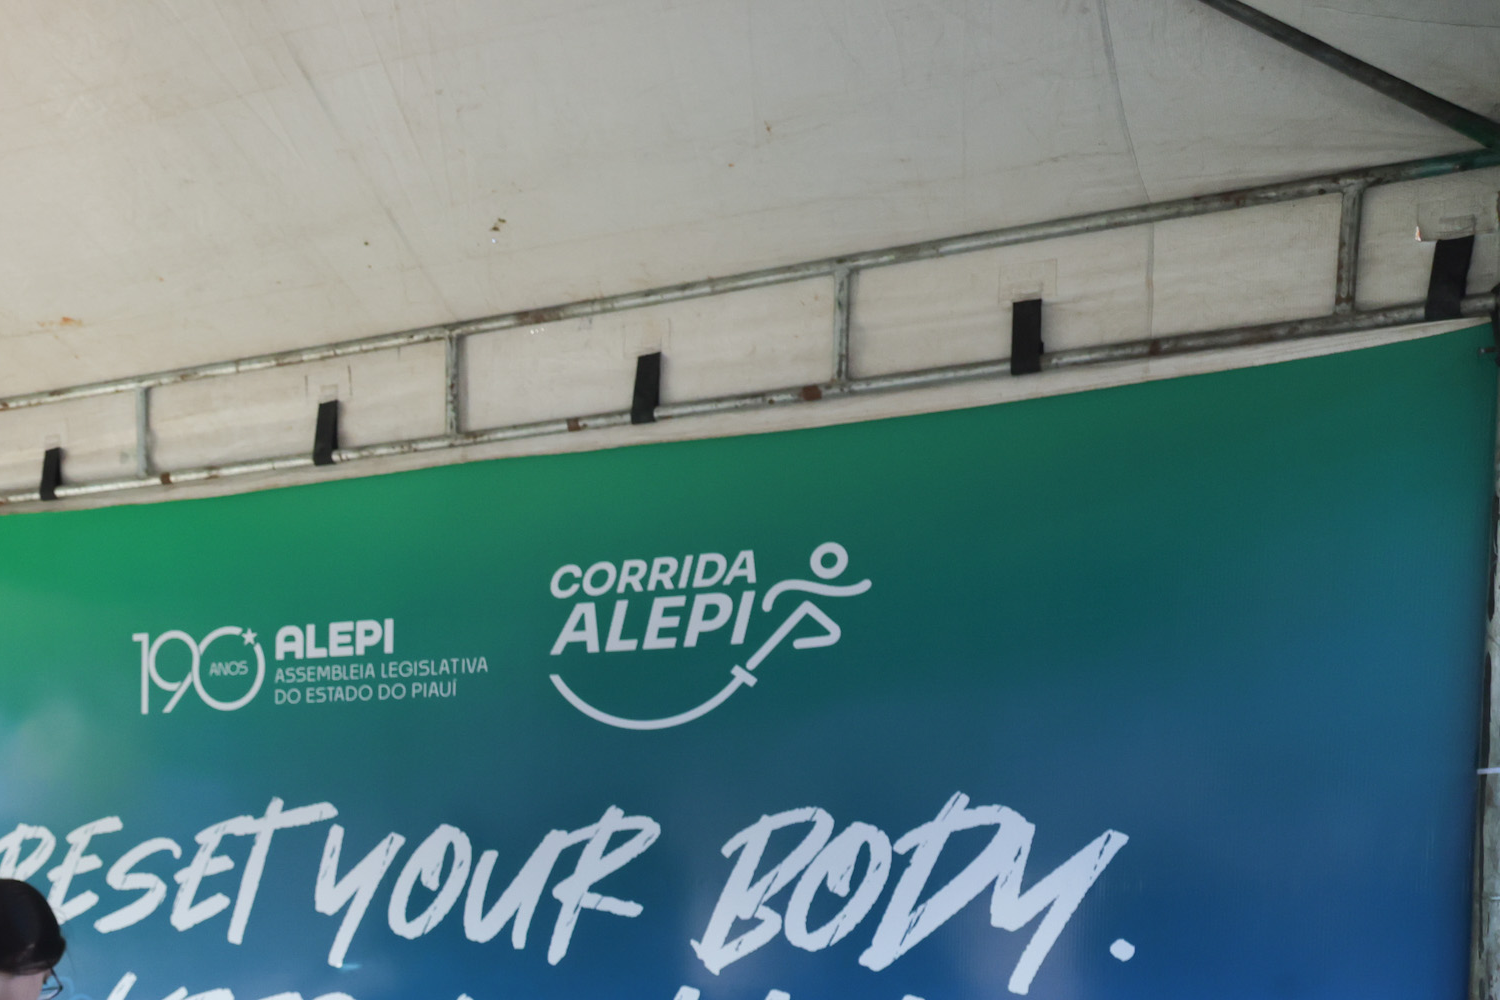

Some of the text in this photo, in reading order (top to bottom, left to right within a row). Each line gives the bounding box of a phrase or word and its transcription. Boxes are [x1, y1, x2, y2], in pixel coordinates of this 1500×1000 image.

[550, 549, 757, 599] CORRIDA
[275, 618, 395, 661] ALEPI
[549, 590, 756, 656] ALEPI
[132, 625, 266, 715] 190
[209, 660, 249, 677] ANOS
[274, 656, 489, 684] ASSEMBLEIA LEGISLATIVA
[274, 678, 457, 705] DO ESTADO DO PIAUÍ
[315, 804, 661, 968] YOUR
[690, 791, 1136, 995] BODY.
